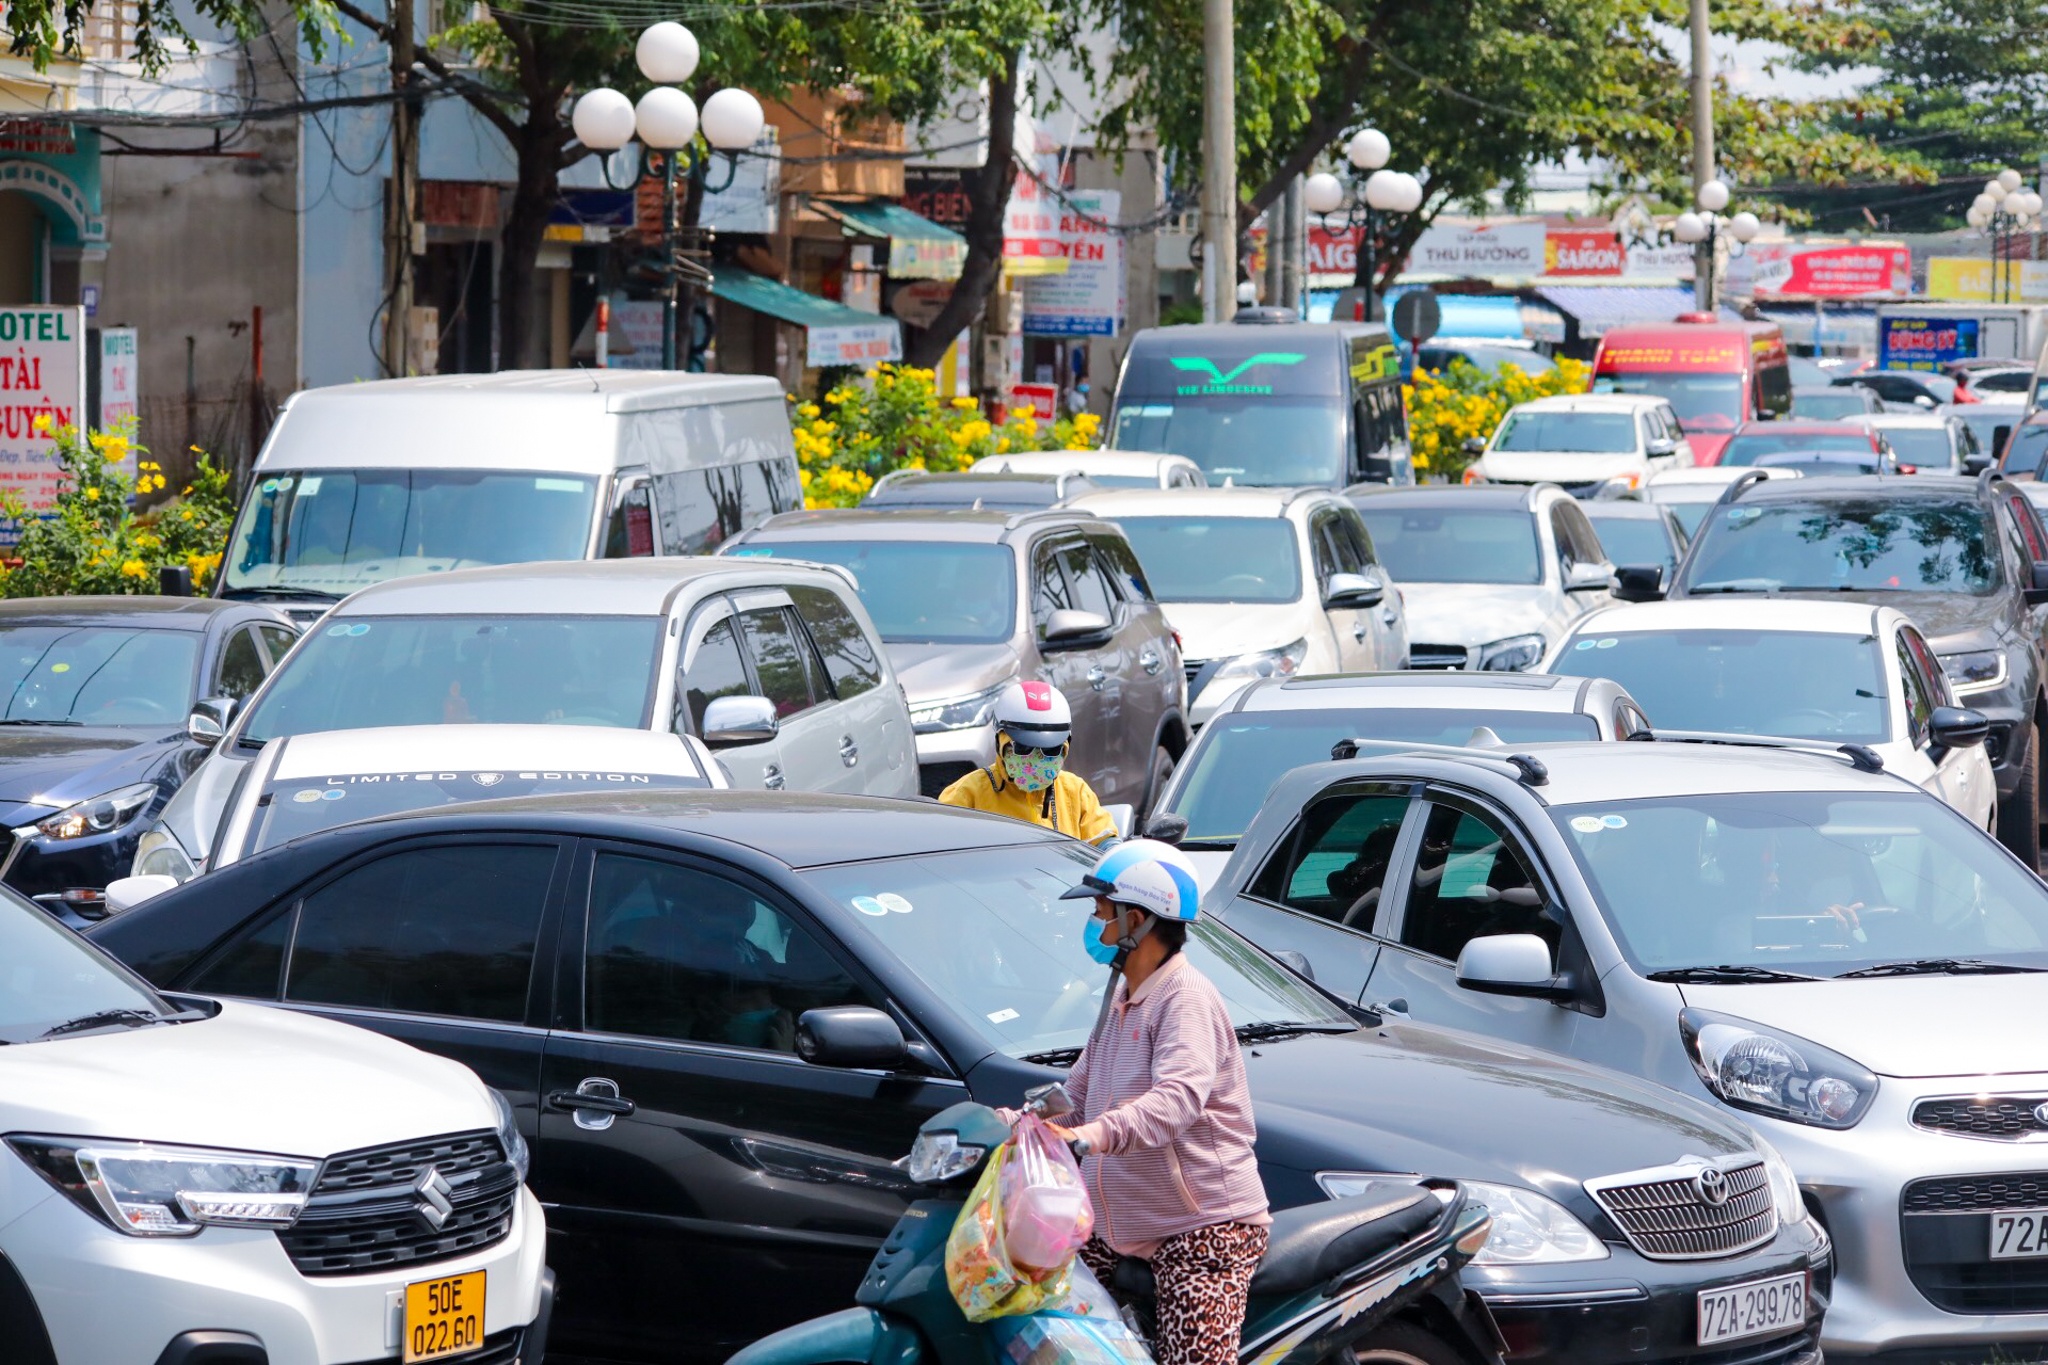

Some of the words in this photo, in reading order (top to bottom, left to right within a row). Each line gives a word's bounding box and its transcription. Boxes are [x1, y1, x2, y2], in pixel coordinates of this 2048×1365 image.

[1308, 243, 1357, 269] AIG
[0, 346, 41, 390] TÀI
[0, 395, 72, 439] UYÊN
[327, 773, 457, 785] LIMITED
[519, 772, 650, 783] EDITION
[429, 1279, 463, 1316] 50E
[414, 1314, 476, 1357] 022.60
